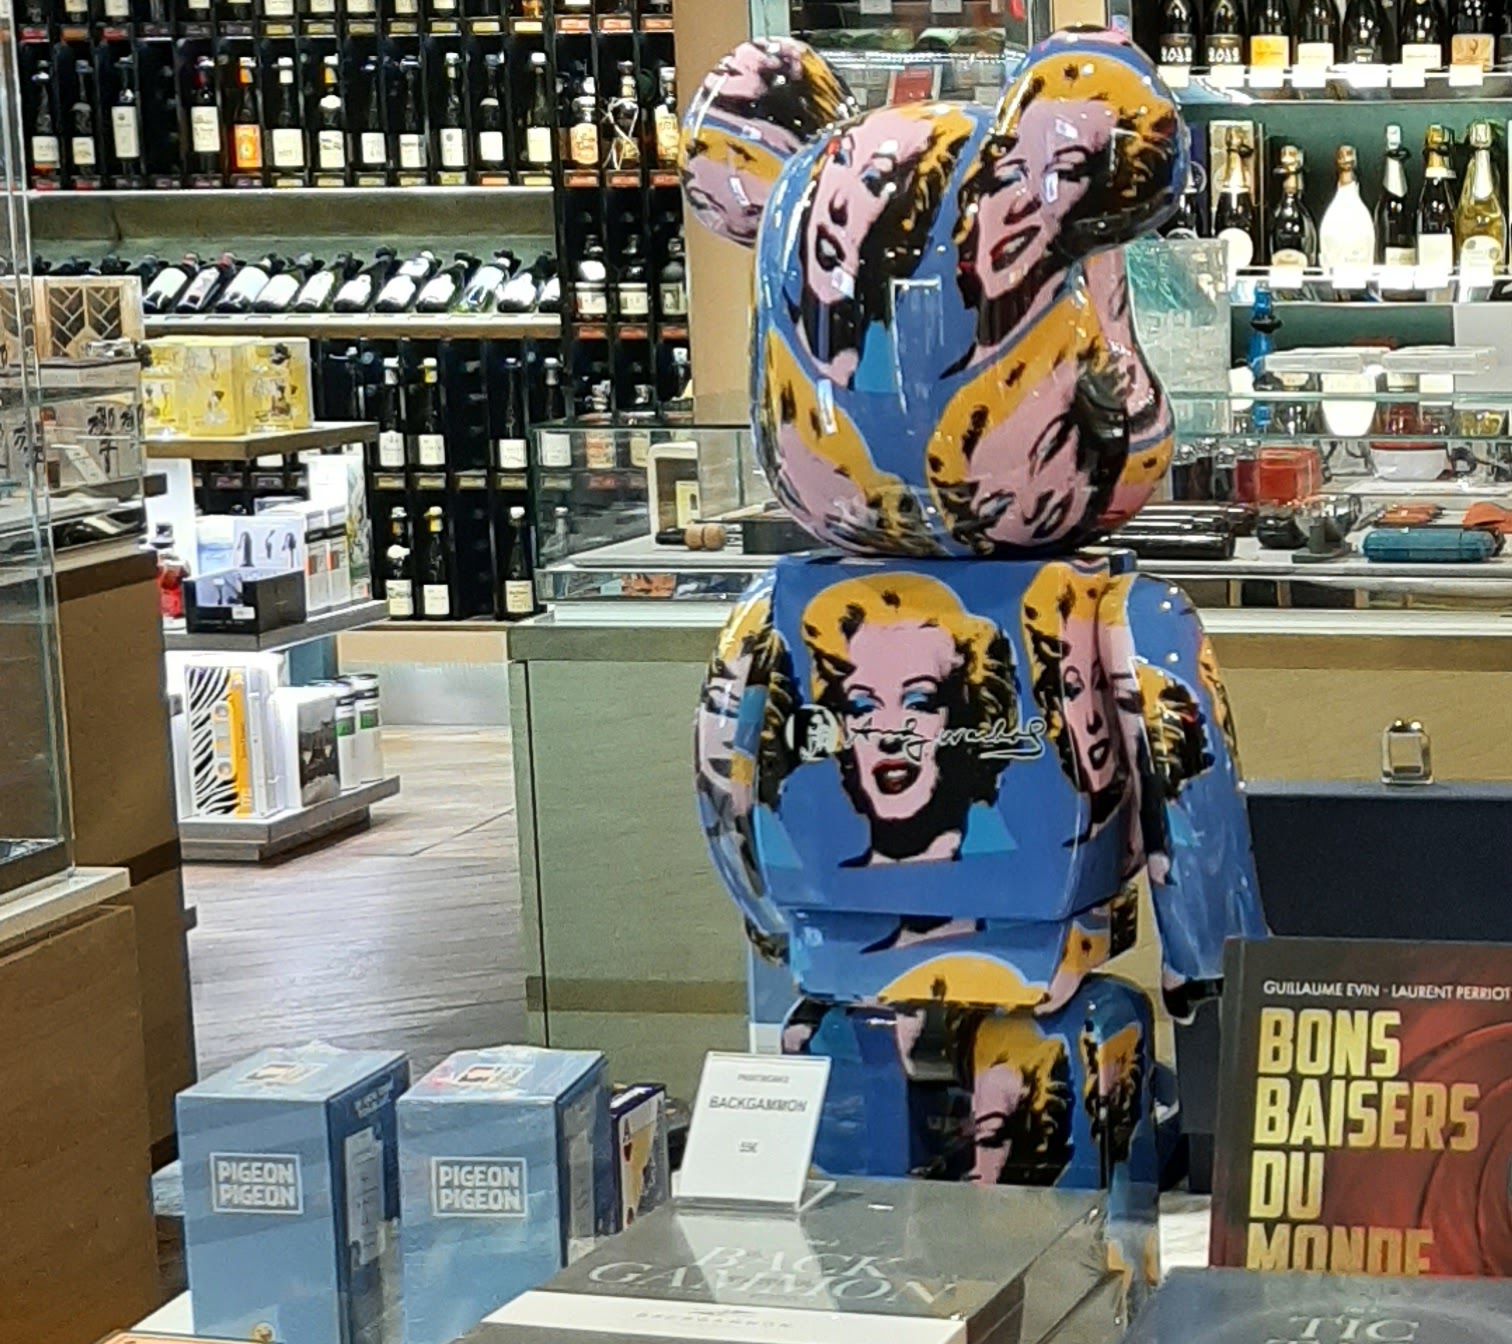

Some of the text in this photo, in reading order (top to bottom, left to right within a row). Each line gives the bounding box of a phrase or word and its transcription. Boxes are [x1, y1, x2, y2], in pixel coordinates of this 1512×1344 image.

[1263, 979, 1344, 998] GUILLAUME
[1346, 983, 1380, 998] EVIN
[1391, 984, 1454, 1000] LAURENT
[1455, 986, 1512, 1002] PERRIOT
[1257, 1007, 1402, 1078] BONS
[708, 1095, 808, 1113] BACKGAMMON
[1253, 1076, 1481, 1152] BAISERS
[217, 1160, 294, 1184] PIGEON
[438, 1165, 520, 1188] PIGEON
[219, 1184, 296, 1207] PIGEON
[1248, 1149, 1326, 1220] DU
[440, 1187, 522, 1211] PIGEON
[1246, 1222, 1435, 1277] MONDE
[1288, 1314, 1420, 1342] TIC
